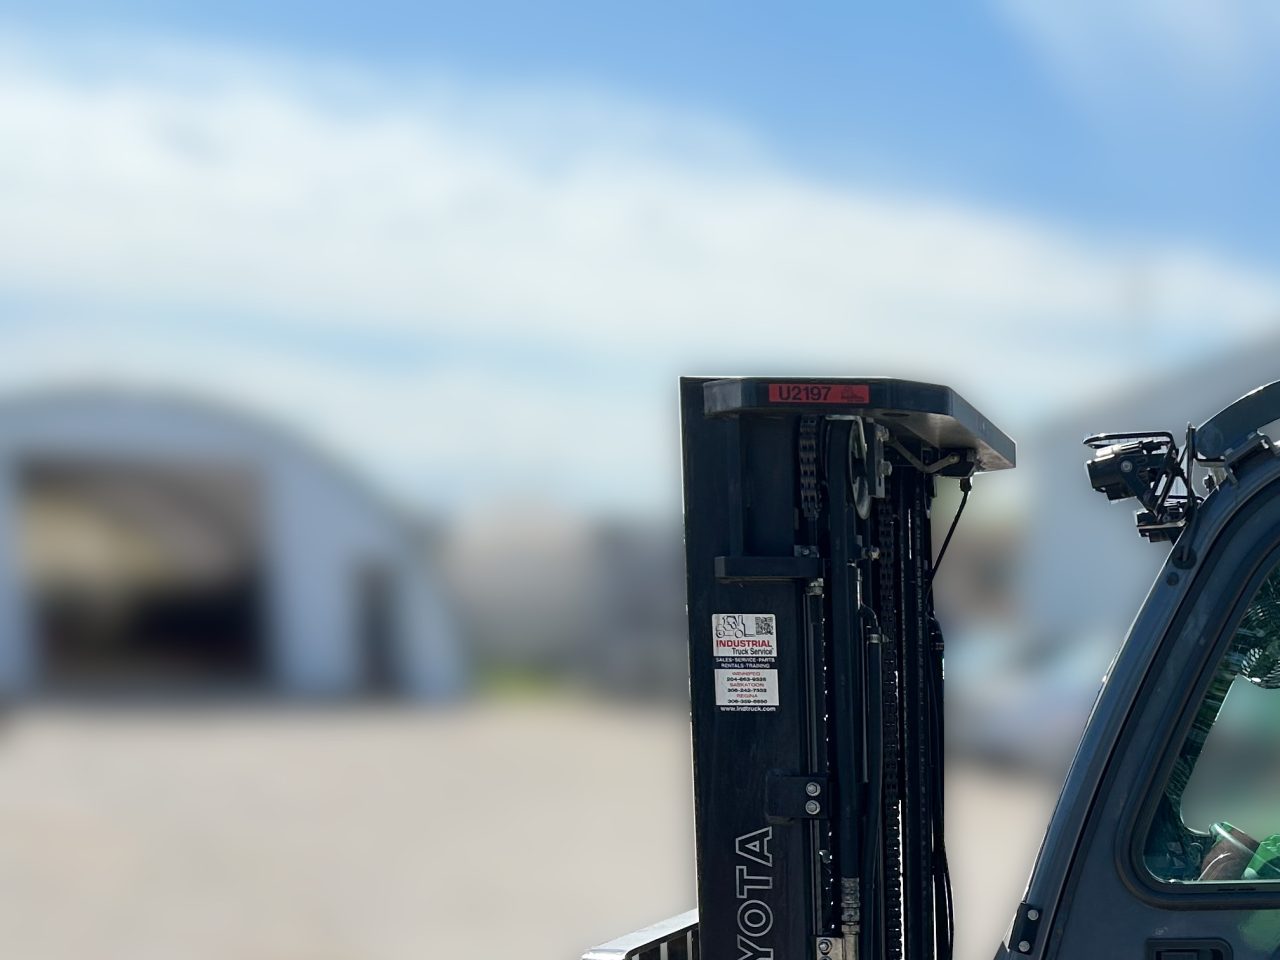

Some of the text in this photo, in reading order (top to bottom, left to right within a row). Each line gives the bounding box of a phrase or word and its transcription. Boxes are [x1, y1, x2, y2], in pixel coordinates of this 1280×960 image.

[779, 385, 832, 401] U2197
[716, 640, 772, 648] INDUSTRIAL
[731, 647, 749, 655] Truck
